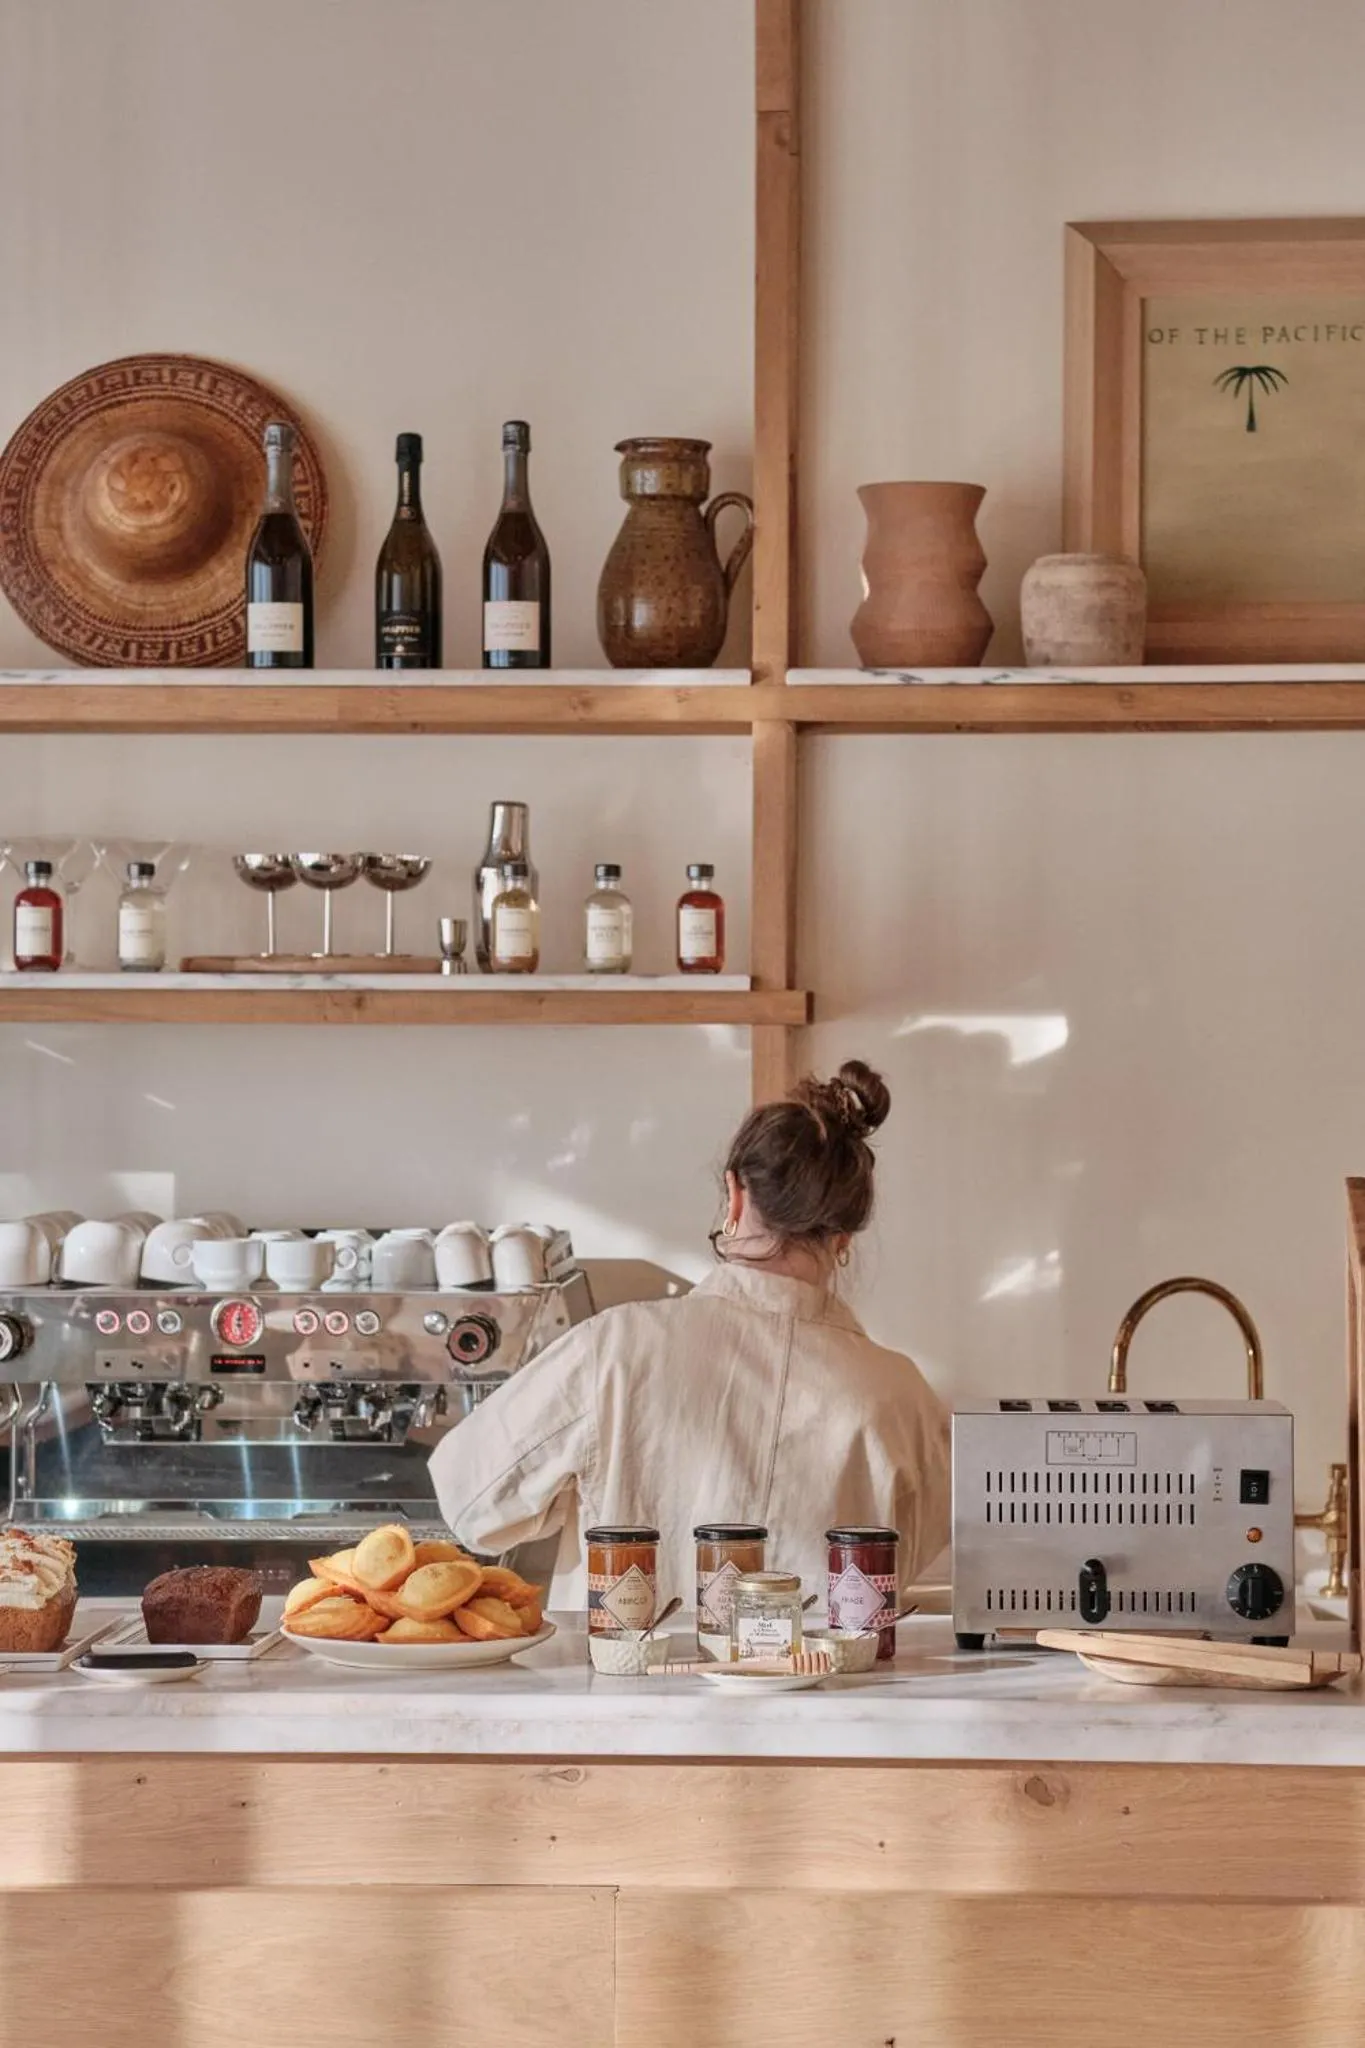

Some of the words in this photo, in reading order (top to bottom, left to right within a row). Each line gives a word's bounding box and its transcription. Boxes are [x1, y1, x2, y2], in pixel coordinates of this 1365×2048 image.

[1147, 327, 1179, 345] OF
[1193, 326, 1246, 346] THE
[1261, 323, 1365, 345] PACIFIC
